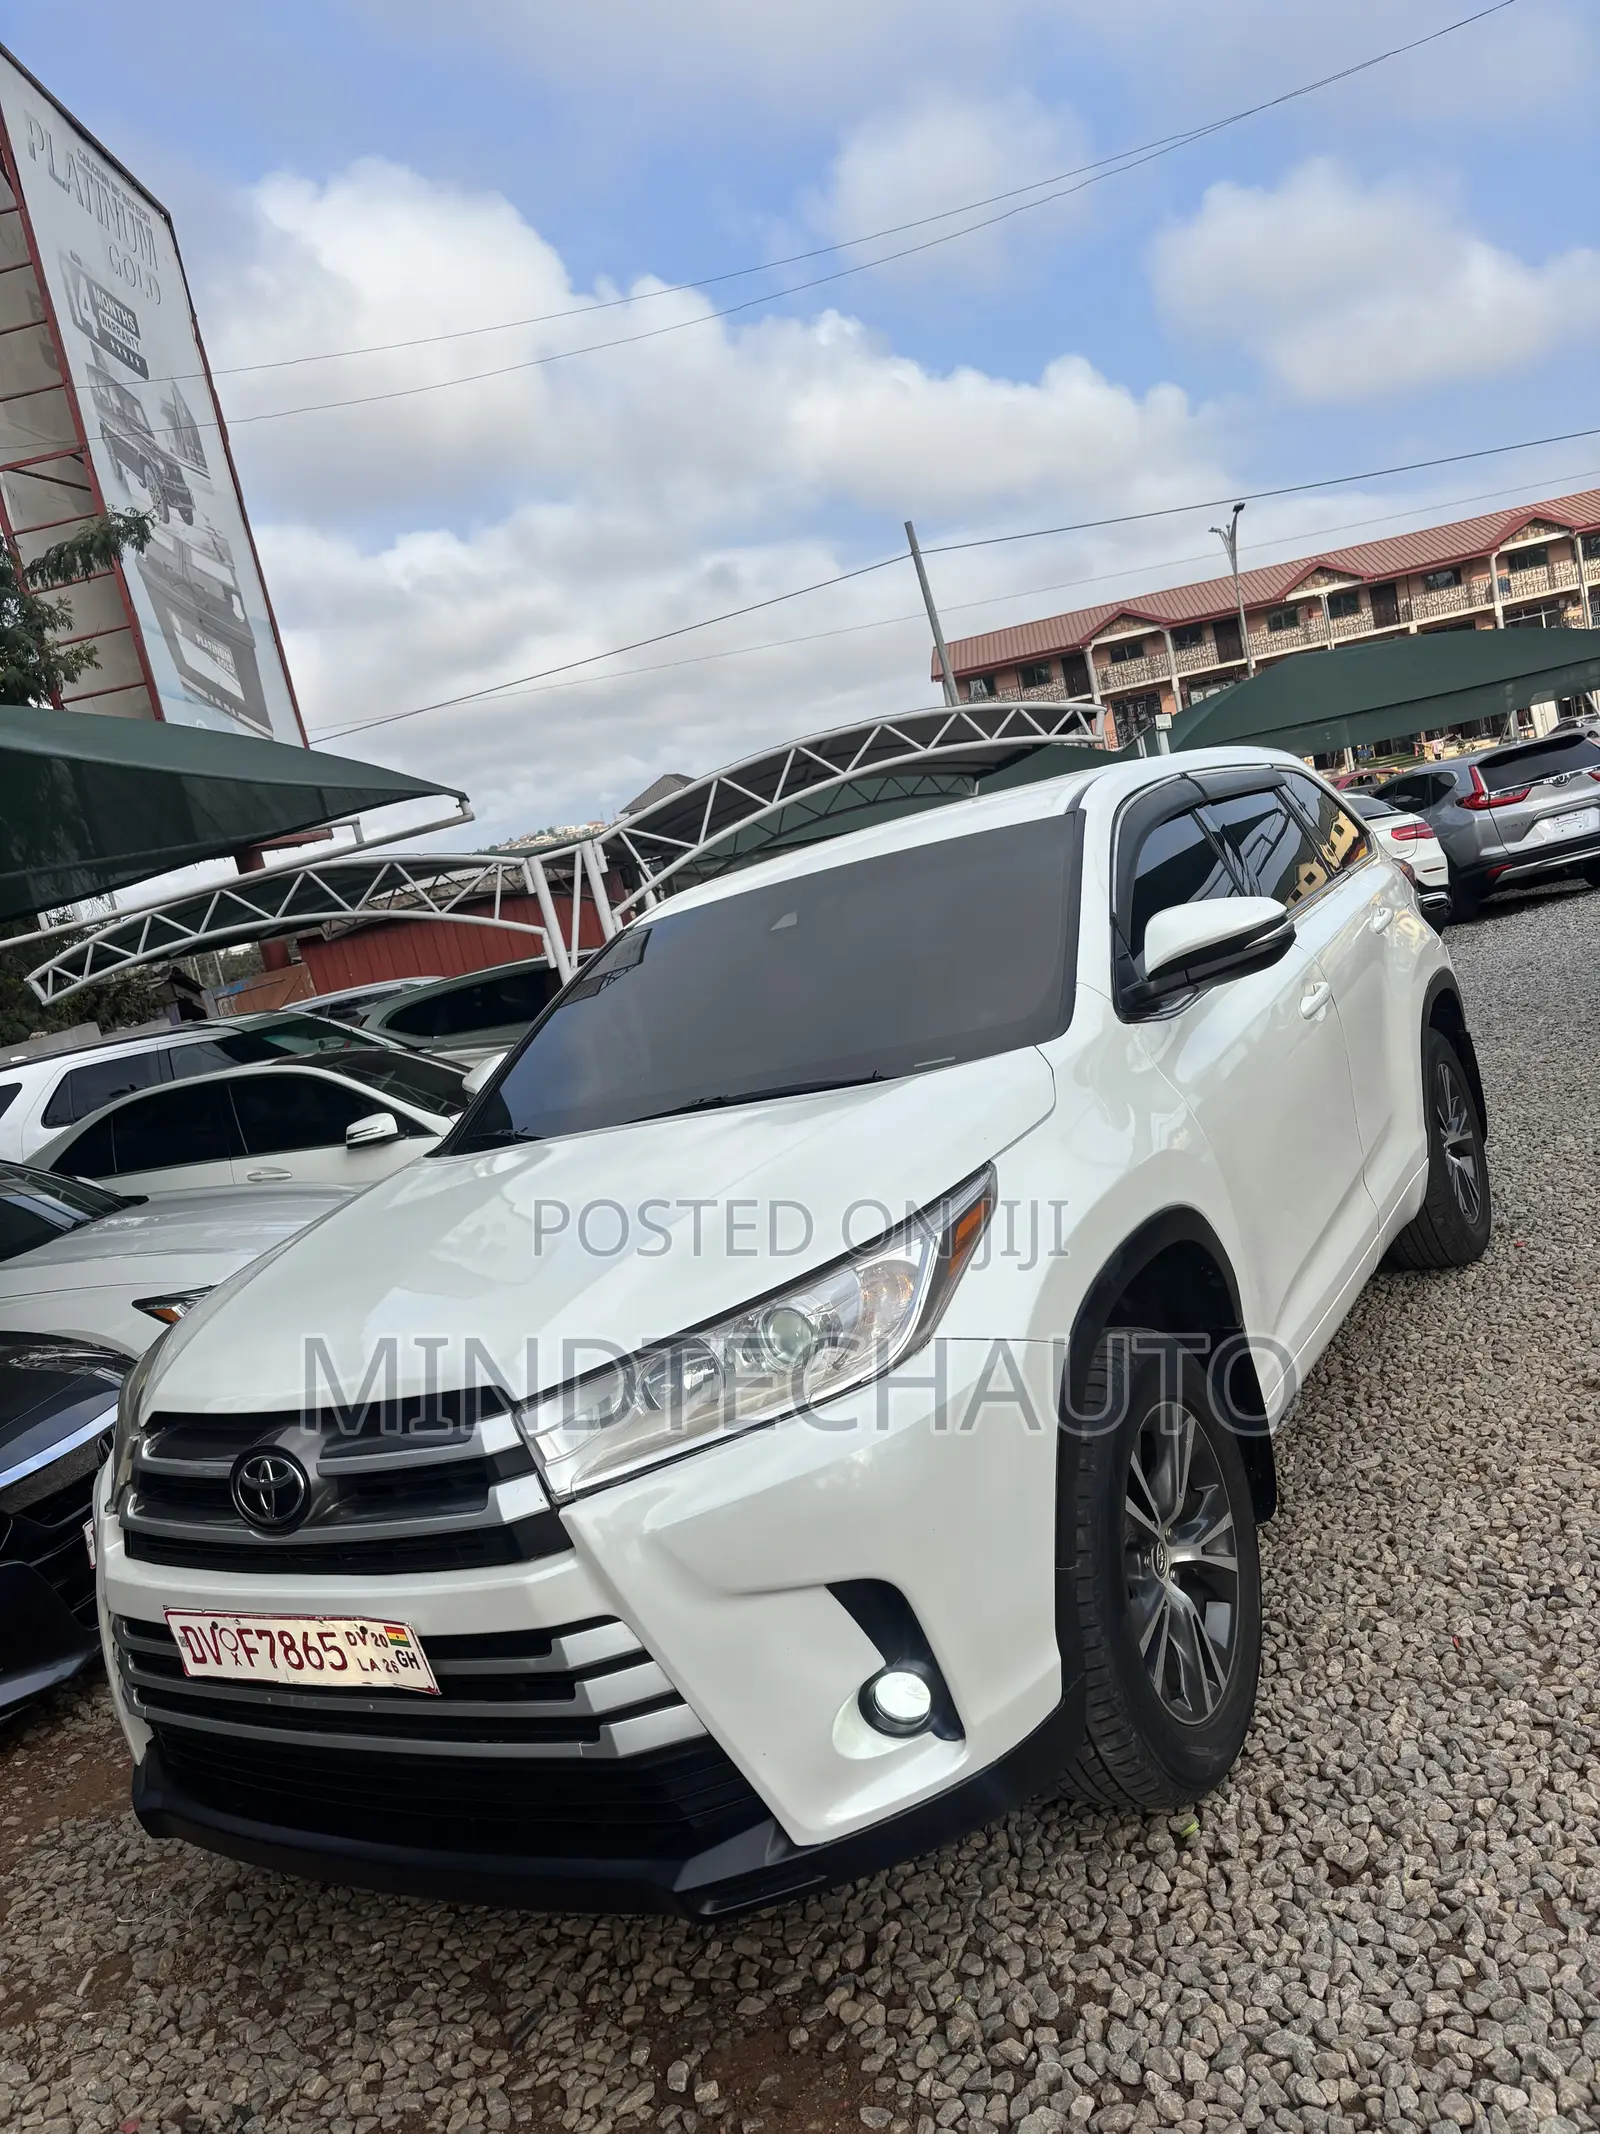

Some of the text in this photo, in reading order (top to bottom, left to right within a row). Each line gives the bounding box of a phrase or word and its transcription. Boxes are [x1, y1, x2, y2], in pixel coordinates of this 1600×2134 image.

[24, 108, 159, 271] PLATINUM
[107, 242, 161, 306] GOLD
[92, 284, 136, 333] MONTHS
[100, 311, 140, 353] WARRANTY
[195, 633, 233, 663] PLATINUM
[216, 656, 236, 674] GOLD
[345, 1630, 389, 1648] DV 20
[356, 1657, 400, 1674] LA 26
[395, 1649, 421, 1670] GH
